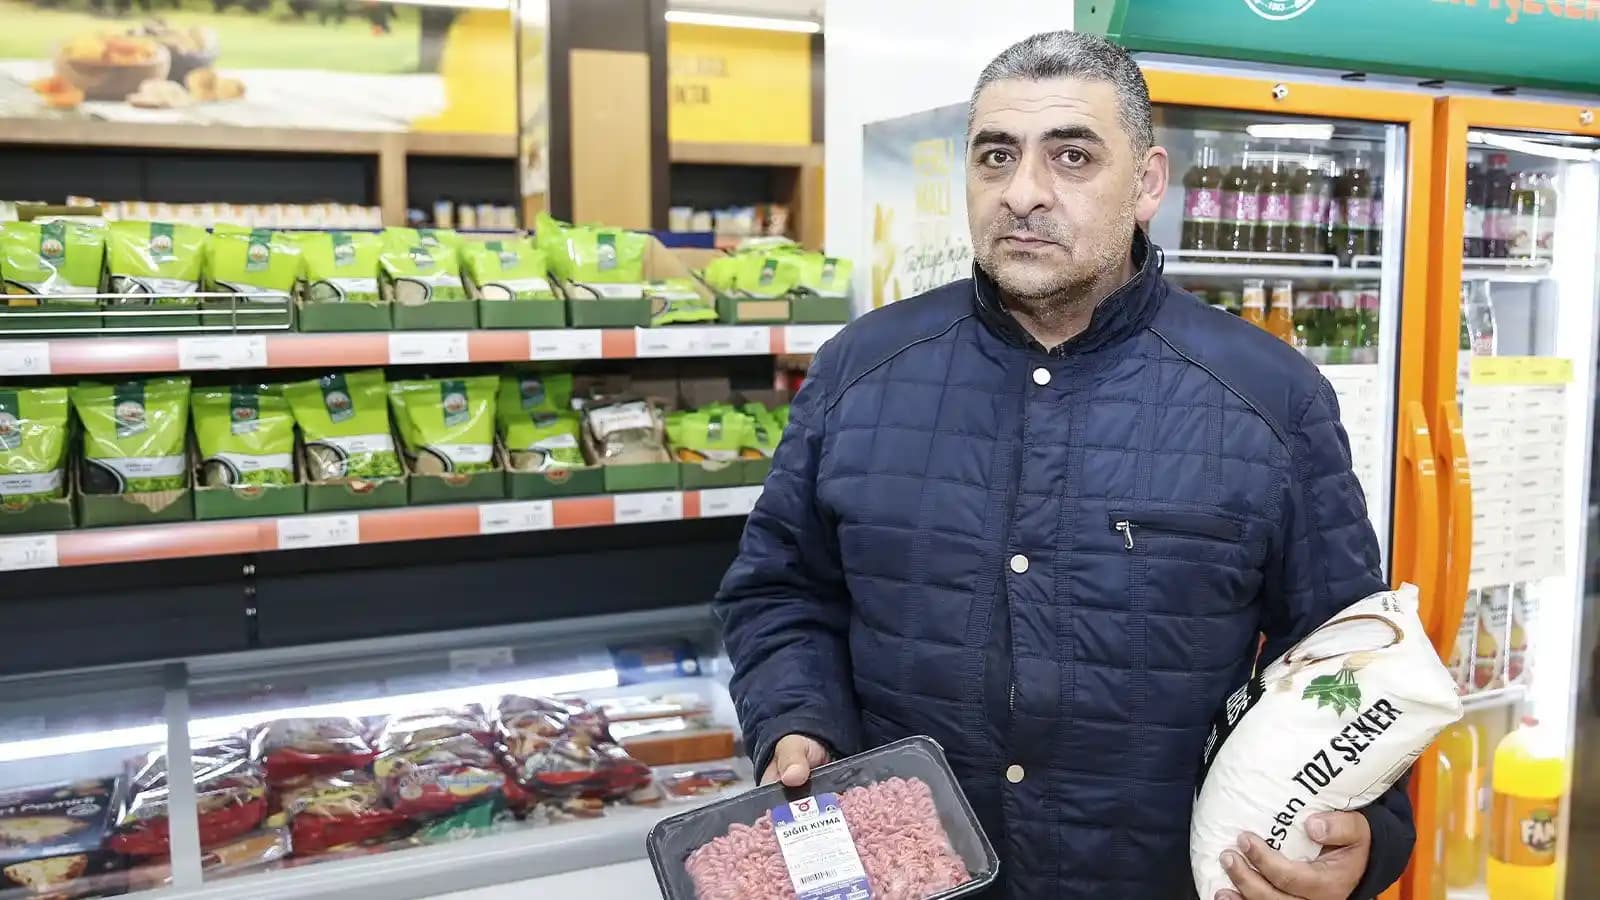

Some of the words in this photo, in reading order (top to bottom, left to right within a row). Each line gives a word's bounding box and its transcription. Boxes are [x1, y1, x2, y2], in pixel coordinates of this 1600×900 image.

[1291, 749, 1343, 795] TOZ
[1330, 698, 1403, 765] ŞEKER
[783, 825, 809, 838] SIĞIR
[811, 816, 841, 830] KIYMA
